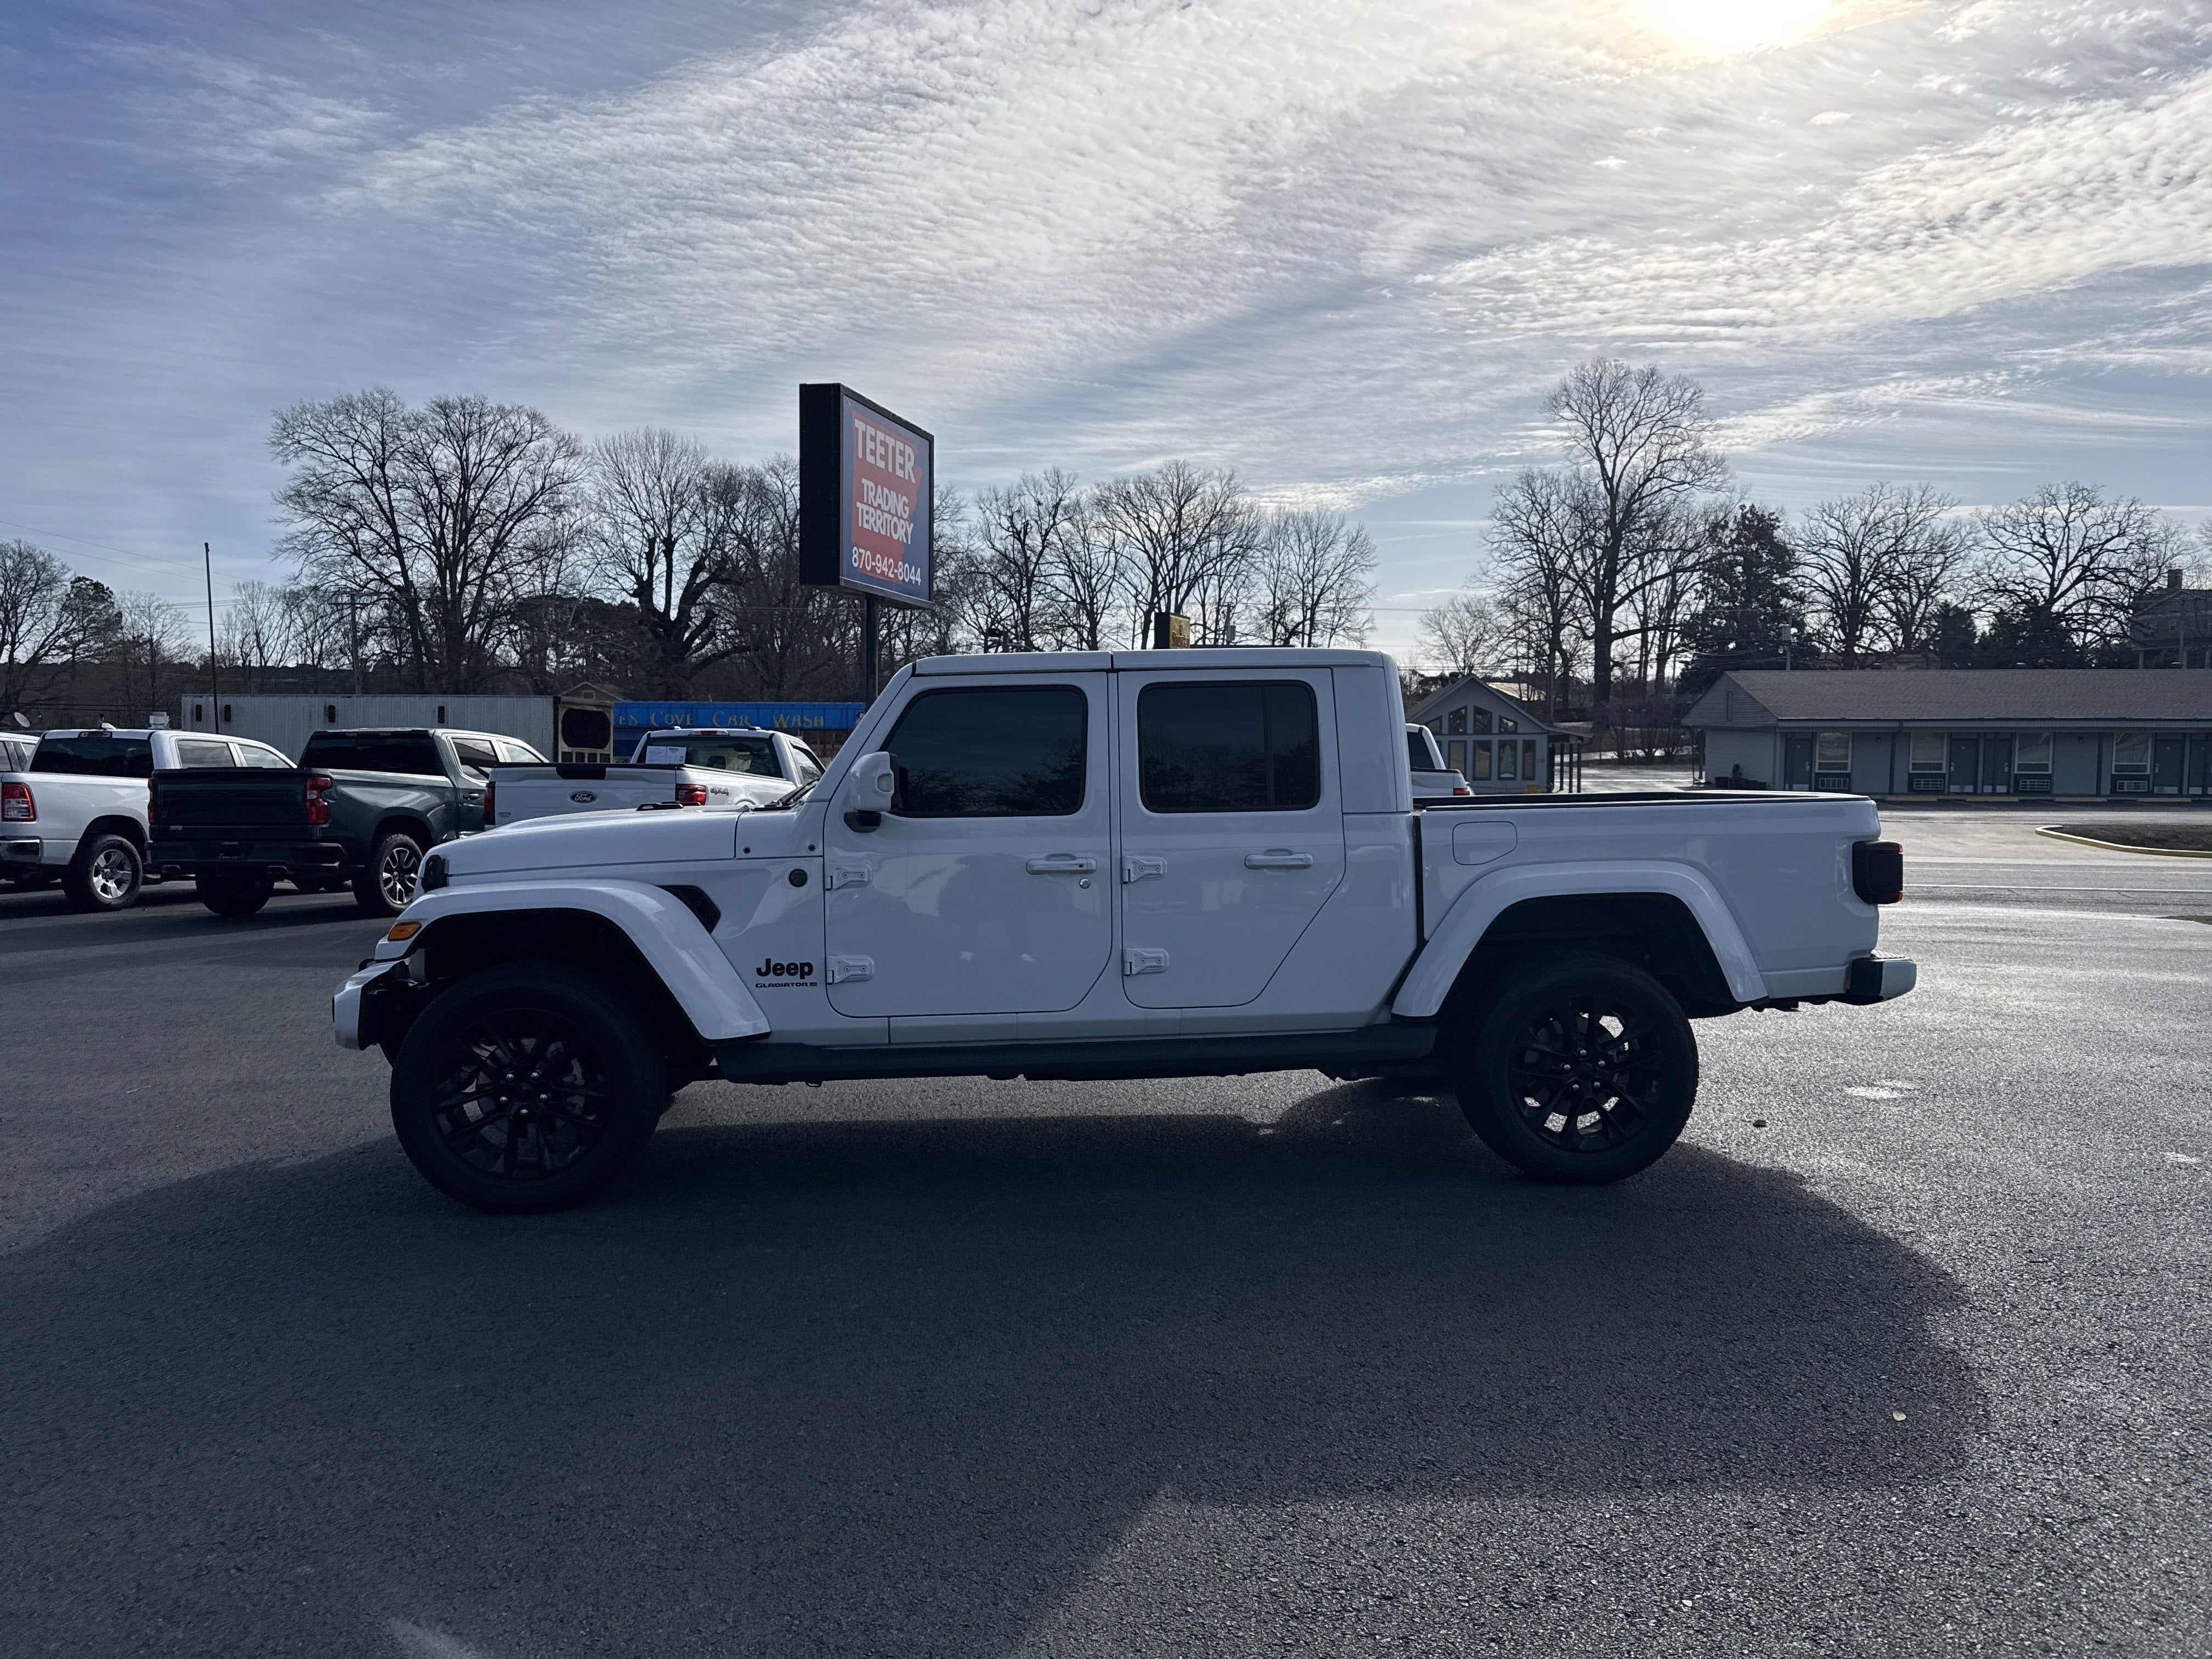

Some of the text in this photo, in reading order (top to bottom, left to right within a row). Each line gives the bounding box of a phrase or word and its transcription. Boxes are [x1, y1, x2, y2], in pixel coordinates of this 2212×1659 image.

[854, 419, 916, 483] TEETER
[861, 478, 910, 517] TRADING
[856, 502, 914, 544] TERRITORY
[852, 546, 922, 586] 870-942-8044
[756, 958, 814, 979] Jeep
